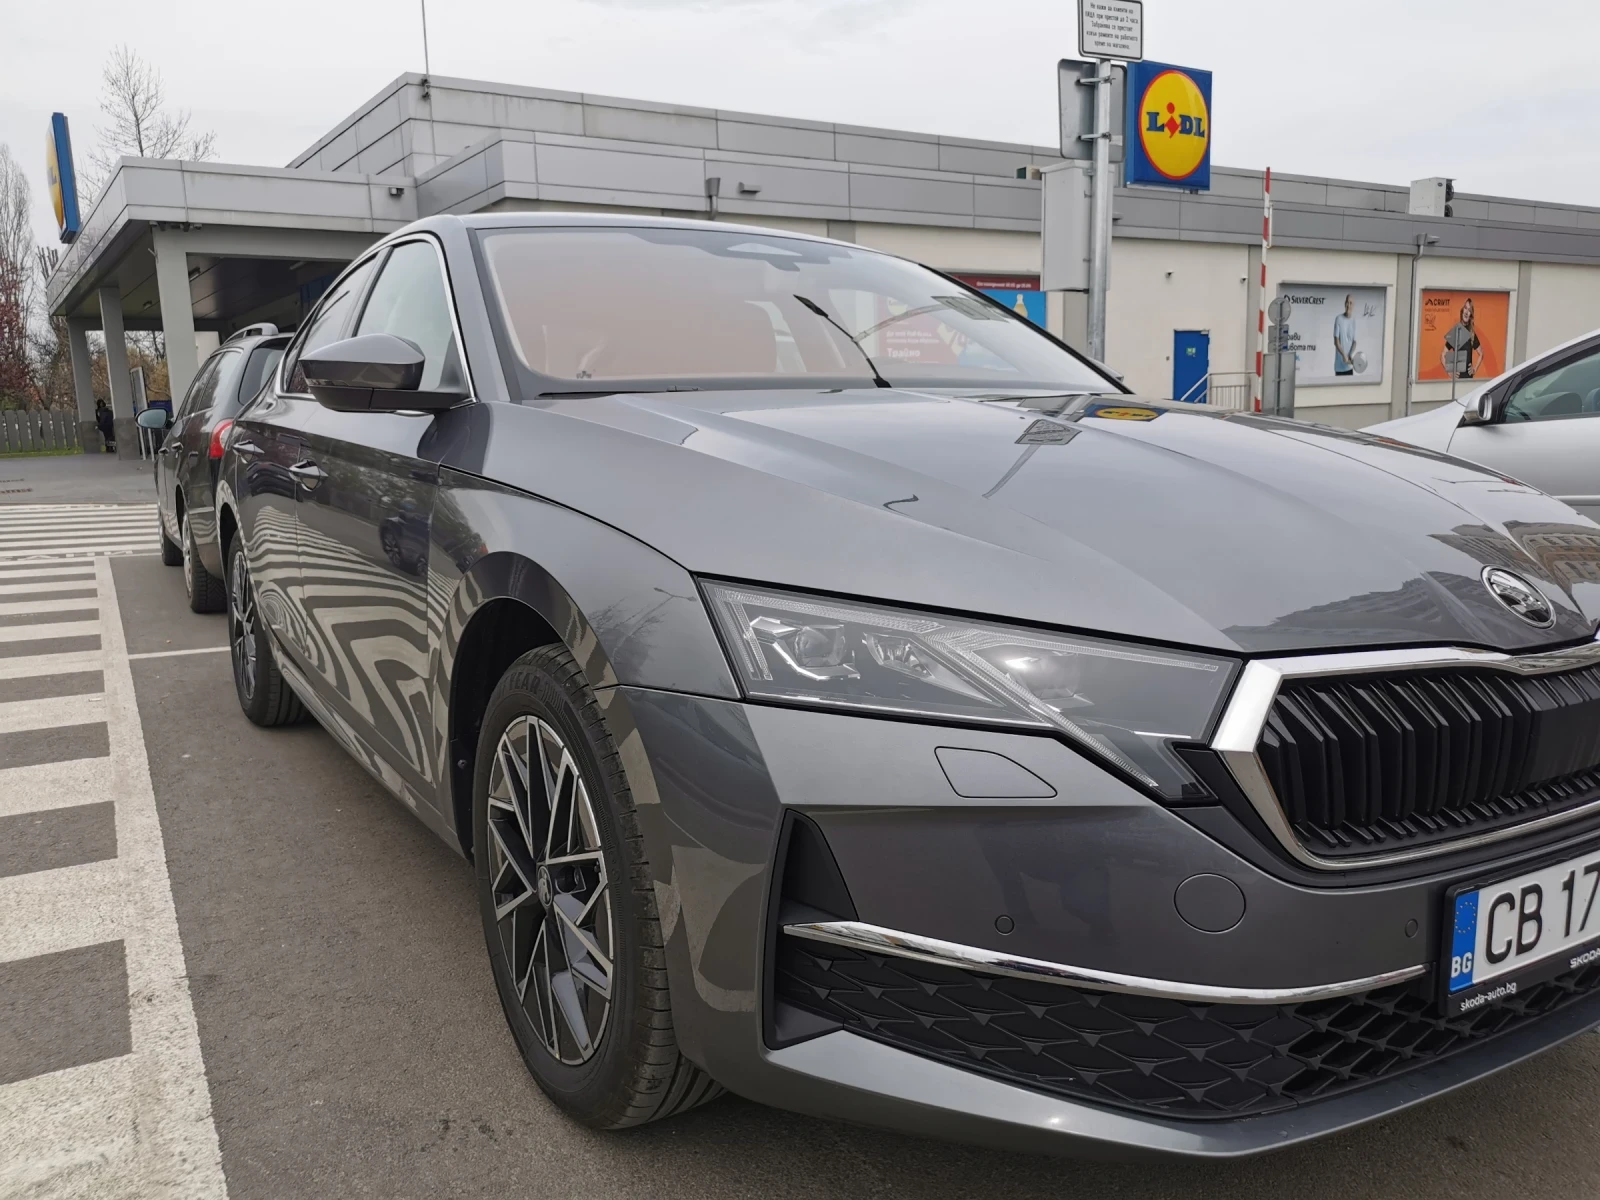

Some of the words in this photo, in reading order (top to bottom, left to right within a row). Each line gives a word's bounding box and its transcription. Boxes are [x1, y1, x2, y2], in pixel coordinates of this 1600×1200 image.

[1486, 883, 1543, 964] CB
[1451, 952, 1473, 979] BG
[1459, 981, 1518, 1012] skoda-auto.bg
